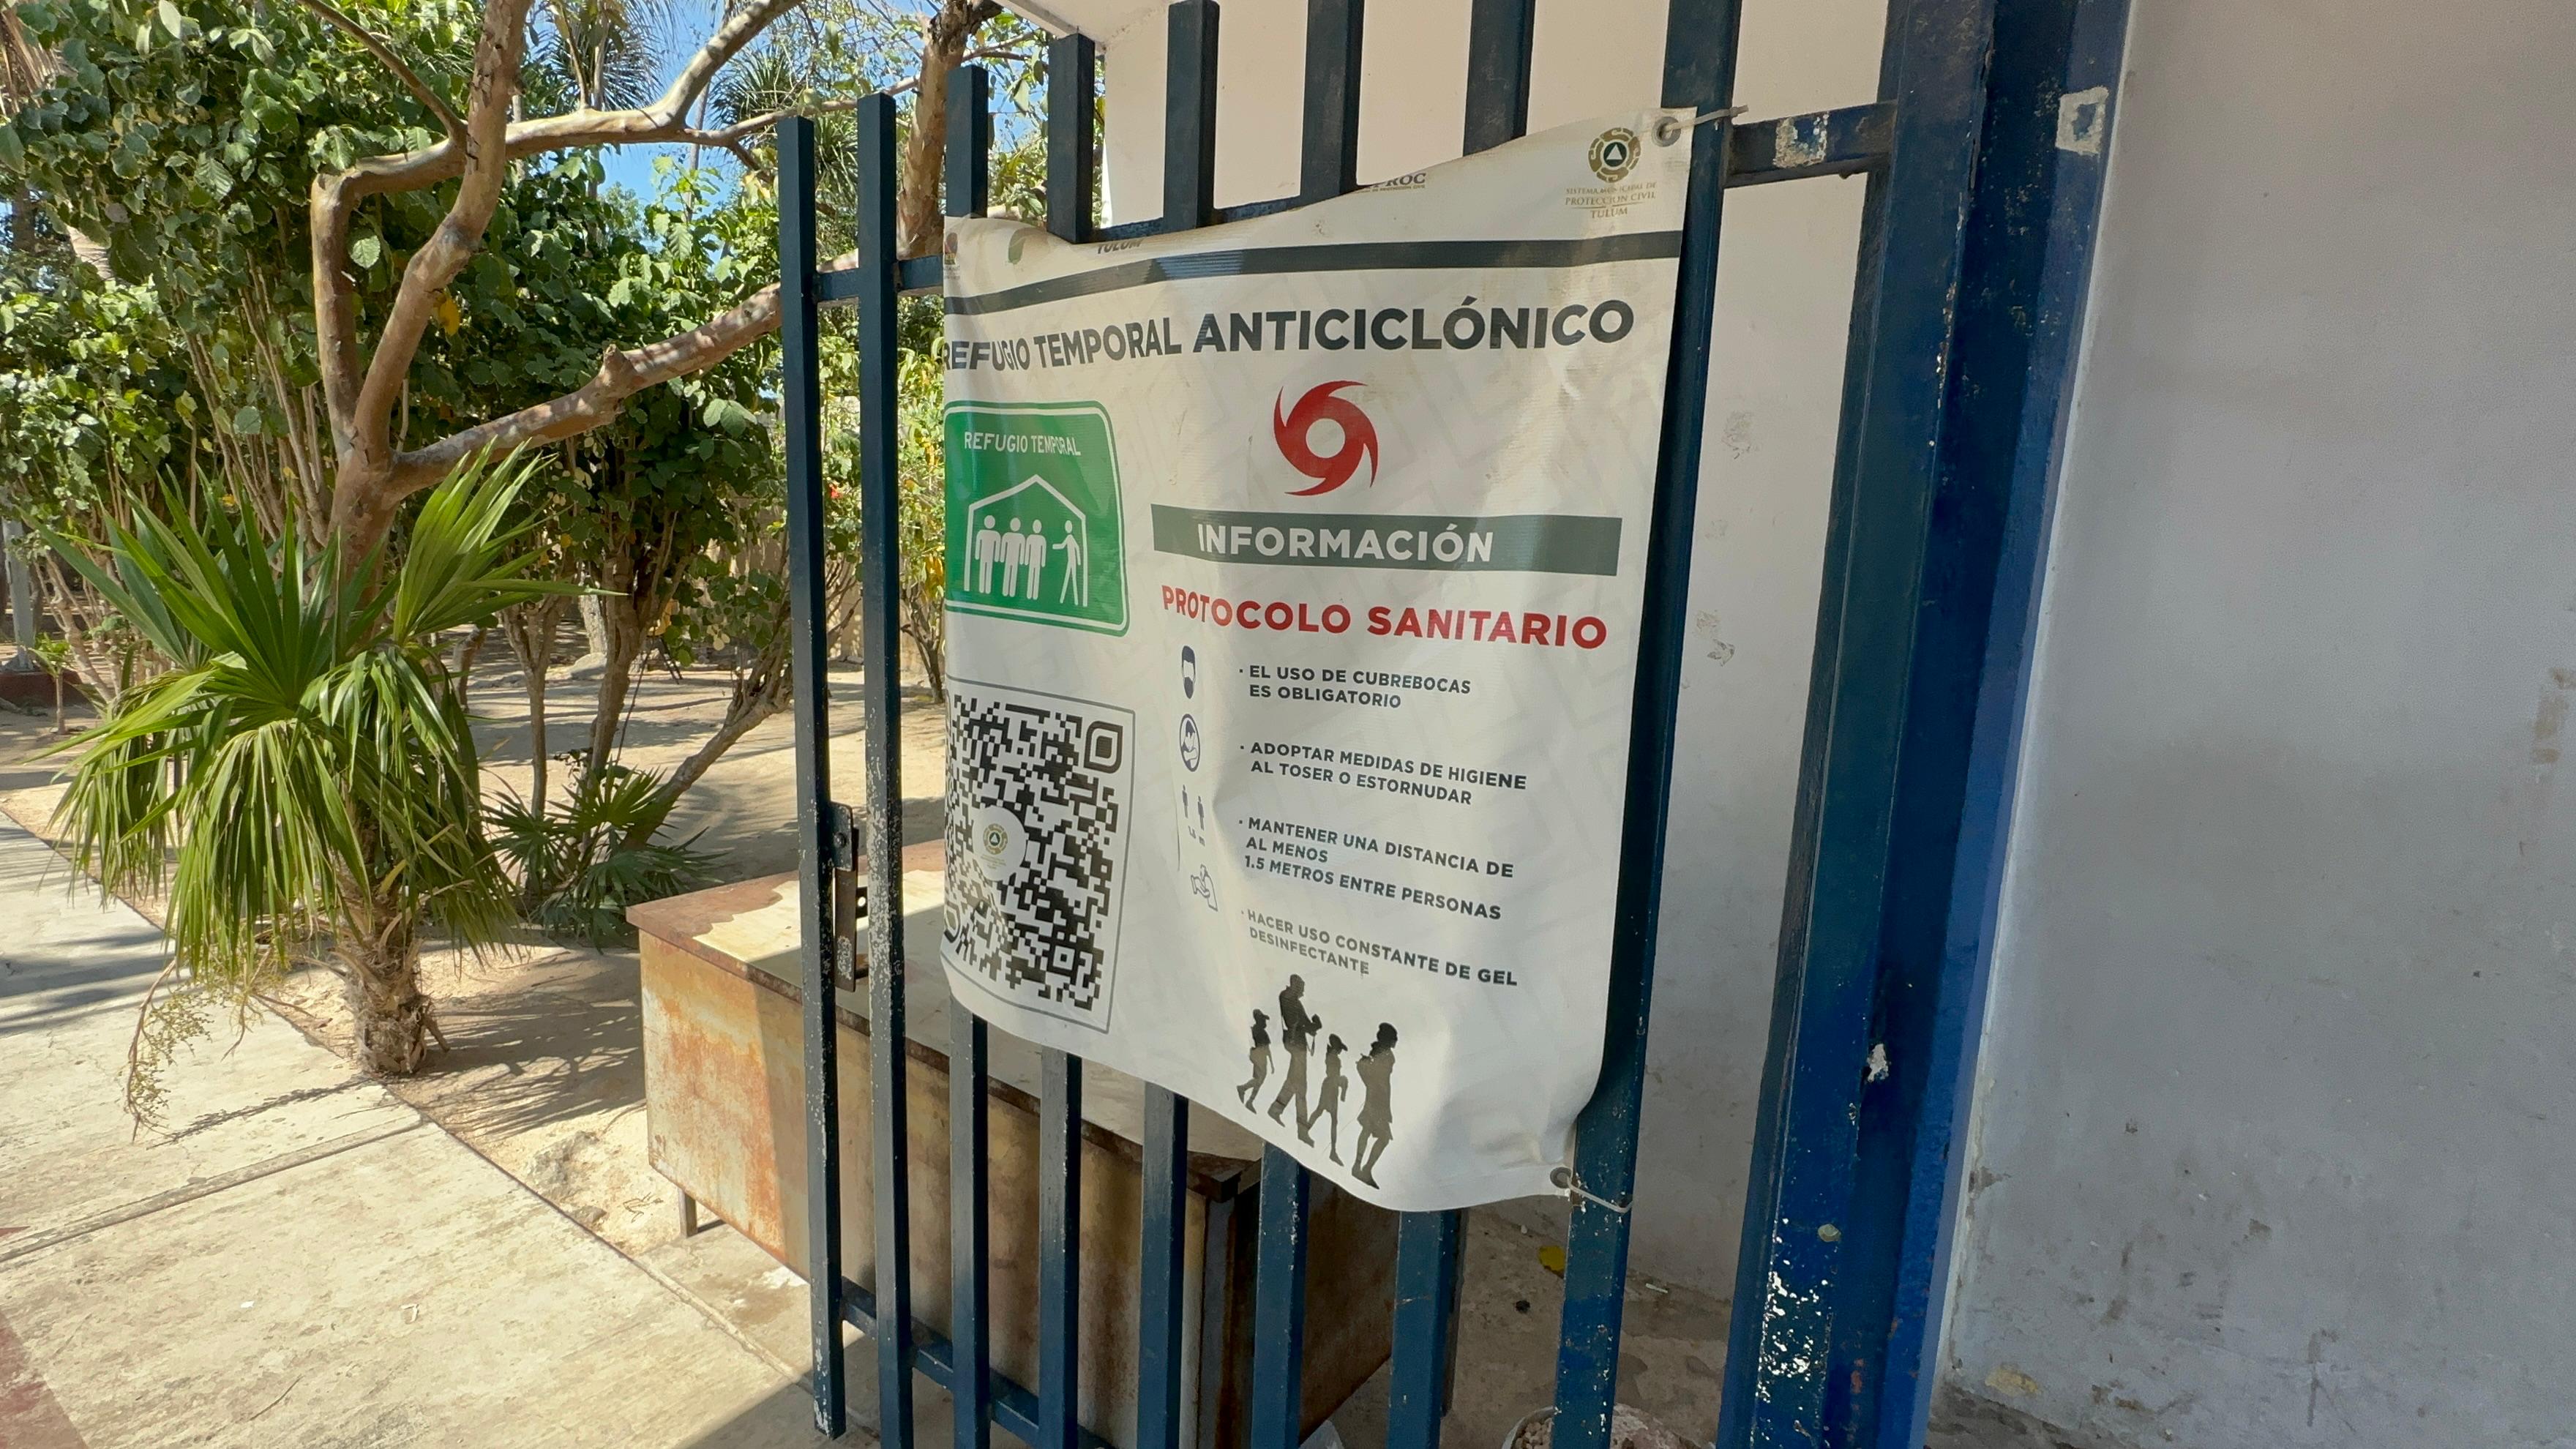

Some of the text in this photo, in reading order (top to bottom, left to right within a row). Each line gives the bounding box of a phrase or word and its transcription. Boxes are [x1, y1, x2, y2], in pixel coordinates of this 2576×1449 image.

[1590, 207, 1628, 219] TULUM
[1630, 191, 1657, 201] CIVIL
[1033, 317, 1182, 369] TEMPORAL
[1193, 296, 1634, 353] ANTICICLÓNICO
[964, 431, 1082, 457] REFUGIO TEMPORAL
[1197, 523, 1494, 563] INFORMACIÓN
[1161, 585, 1607, 649] PROTOCOLO SANITARIO
[1249, 664, 1471, 694] EL USO DE CUBREBOCAS
[1249, 684, 1401, 708] ES OBLIGATORIO
[1251, 742, 1527, 790] ADOPTAR MEDIDAS DE HIGIENE
[1251, 760, 1472, 805] AL TOSER O ESTORNUDAR
[1246, 836, 1328, 863] AL MENOS
[1248, 817, 1514, 878] MANTENER UNA DISTANCIA DE
[1244, 855, 1502, 920] 1.5 METROS ENTRE PERSONAS
[1248, 909, 1518, 986] HACER USO CONSTANTE DE GEL
[1249, 926, 1370, 975] DESINFECTANTE
